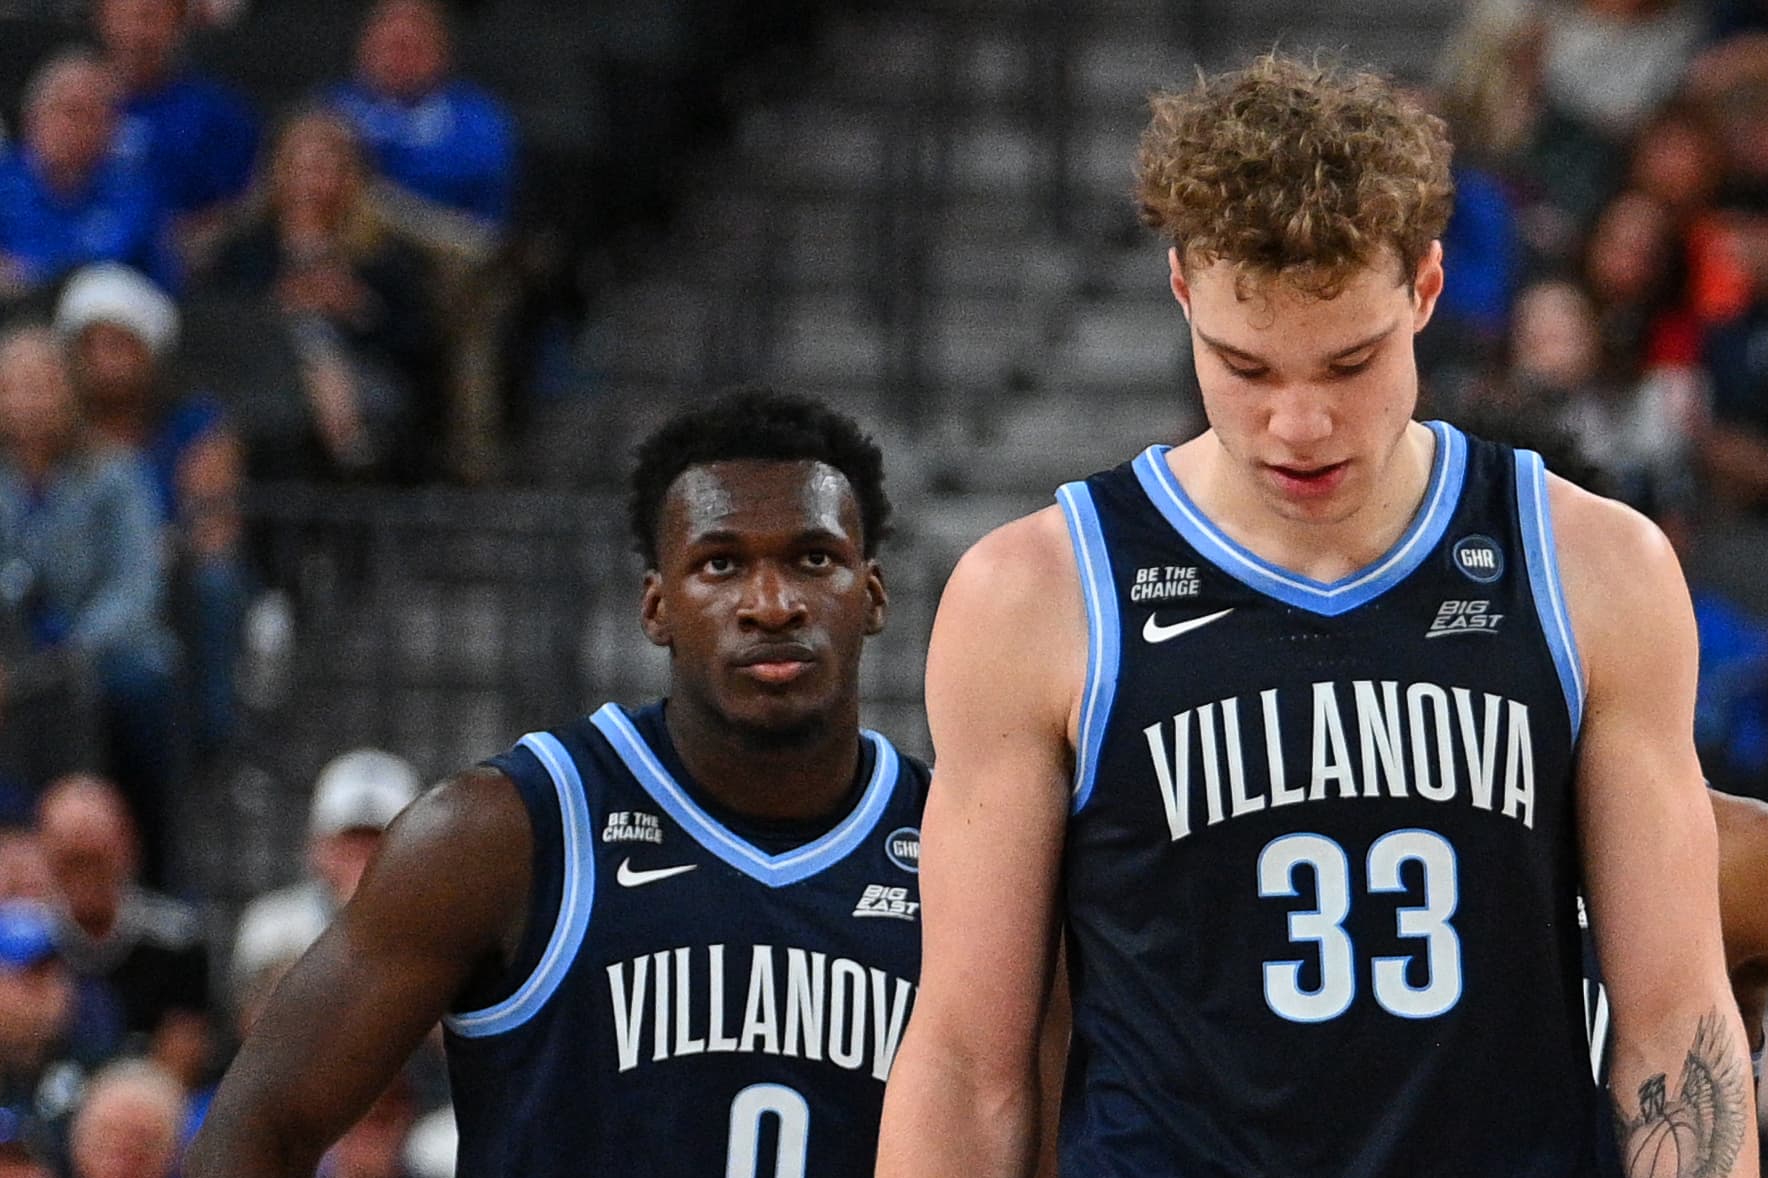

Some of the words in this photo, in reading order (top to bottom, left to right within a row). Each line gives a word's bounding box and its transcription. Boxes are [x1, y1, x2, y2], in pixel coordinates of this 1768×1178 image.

[1460, 548, 1495, 568] GHR
[1136, 567, 1159, 583] BE
[1164, 566, 1197, 580] THE
[1130, 580, 1200, 602] CHANGE
[1437, 600, 1490, 616] BIG
[1430, 614, 1504, 630] EAST
[1143, 680, 1534, 842] VILLANOVA
[608, 811, 630, 826] BE
[633, 811, 659, 828] THE
[602, 825, 662, 844] CHANGE
[863, 884, 908, 900] BIG
[856, 897, 919, 914] EAST
[1256, 828, 1464, 1024] 33
[606, 944, 920, 1083] VILLANOV
